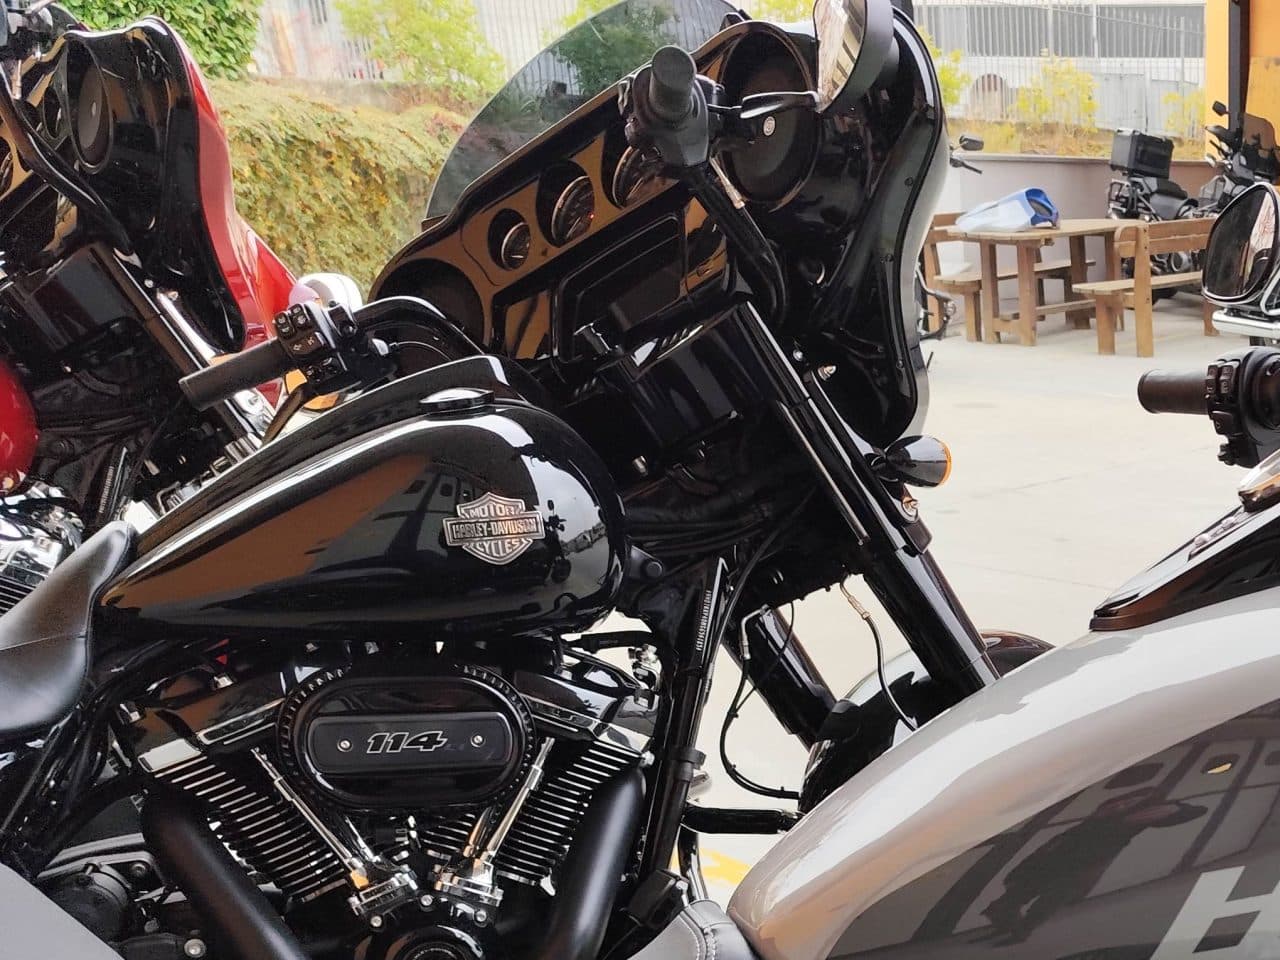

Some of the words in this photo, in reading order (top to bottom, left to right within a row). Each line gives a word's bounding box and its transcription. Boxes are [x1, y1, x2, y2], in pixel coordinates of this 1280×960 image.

[469, 503, 519, 518] MOTOR
[452, 518, 537, 539] HARLEY-DAVIDSON
[477, 539, 520, 557] CYCLES
[366, 730, 448, 754] 114
